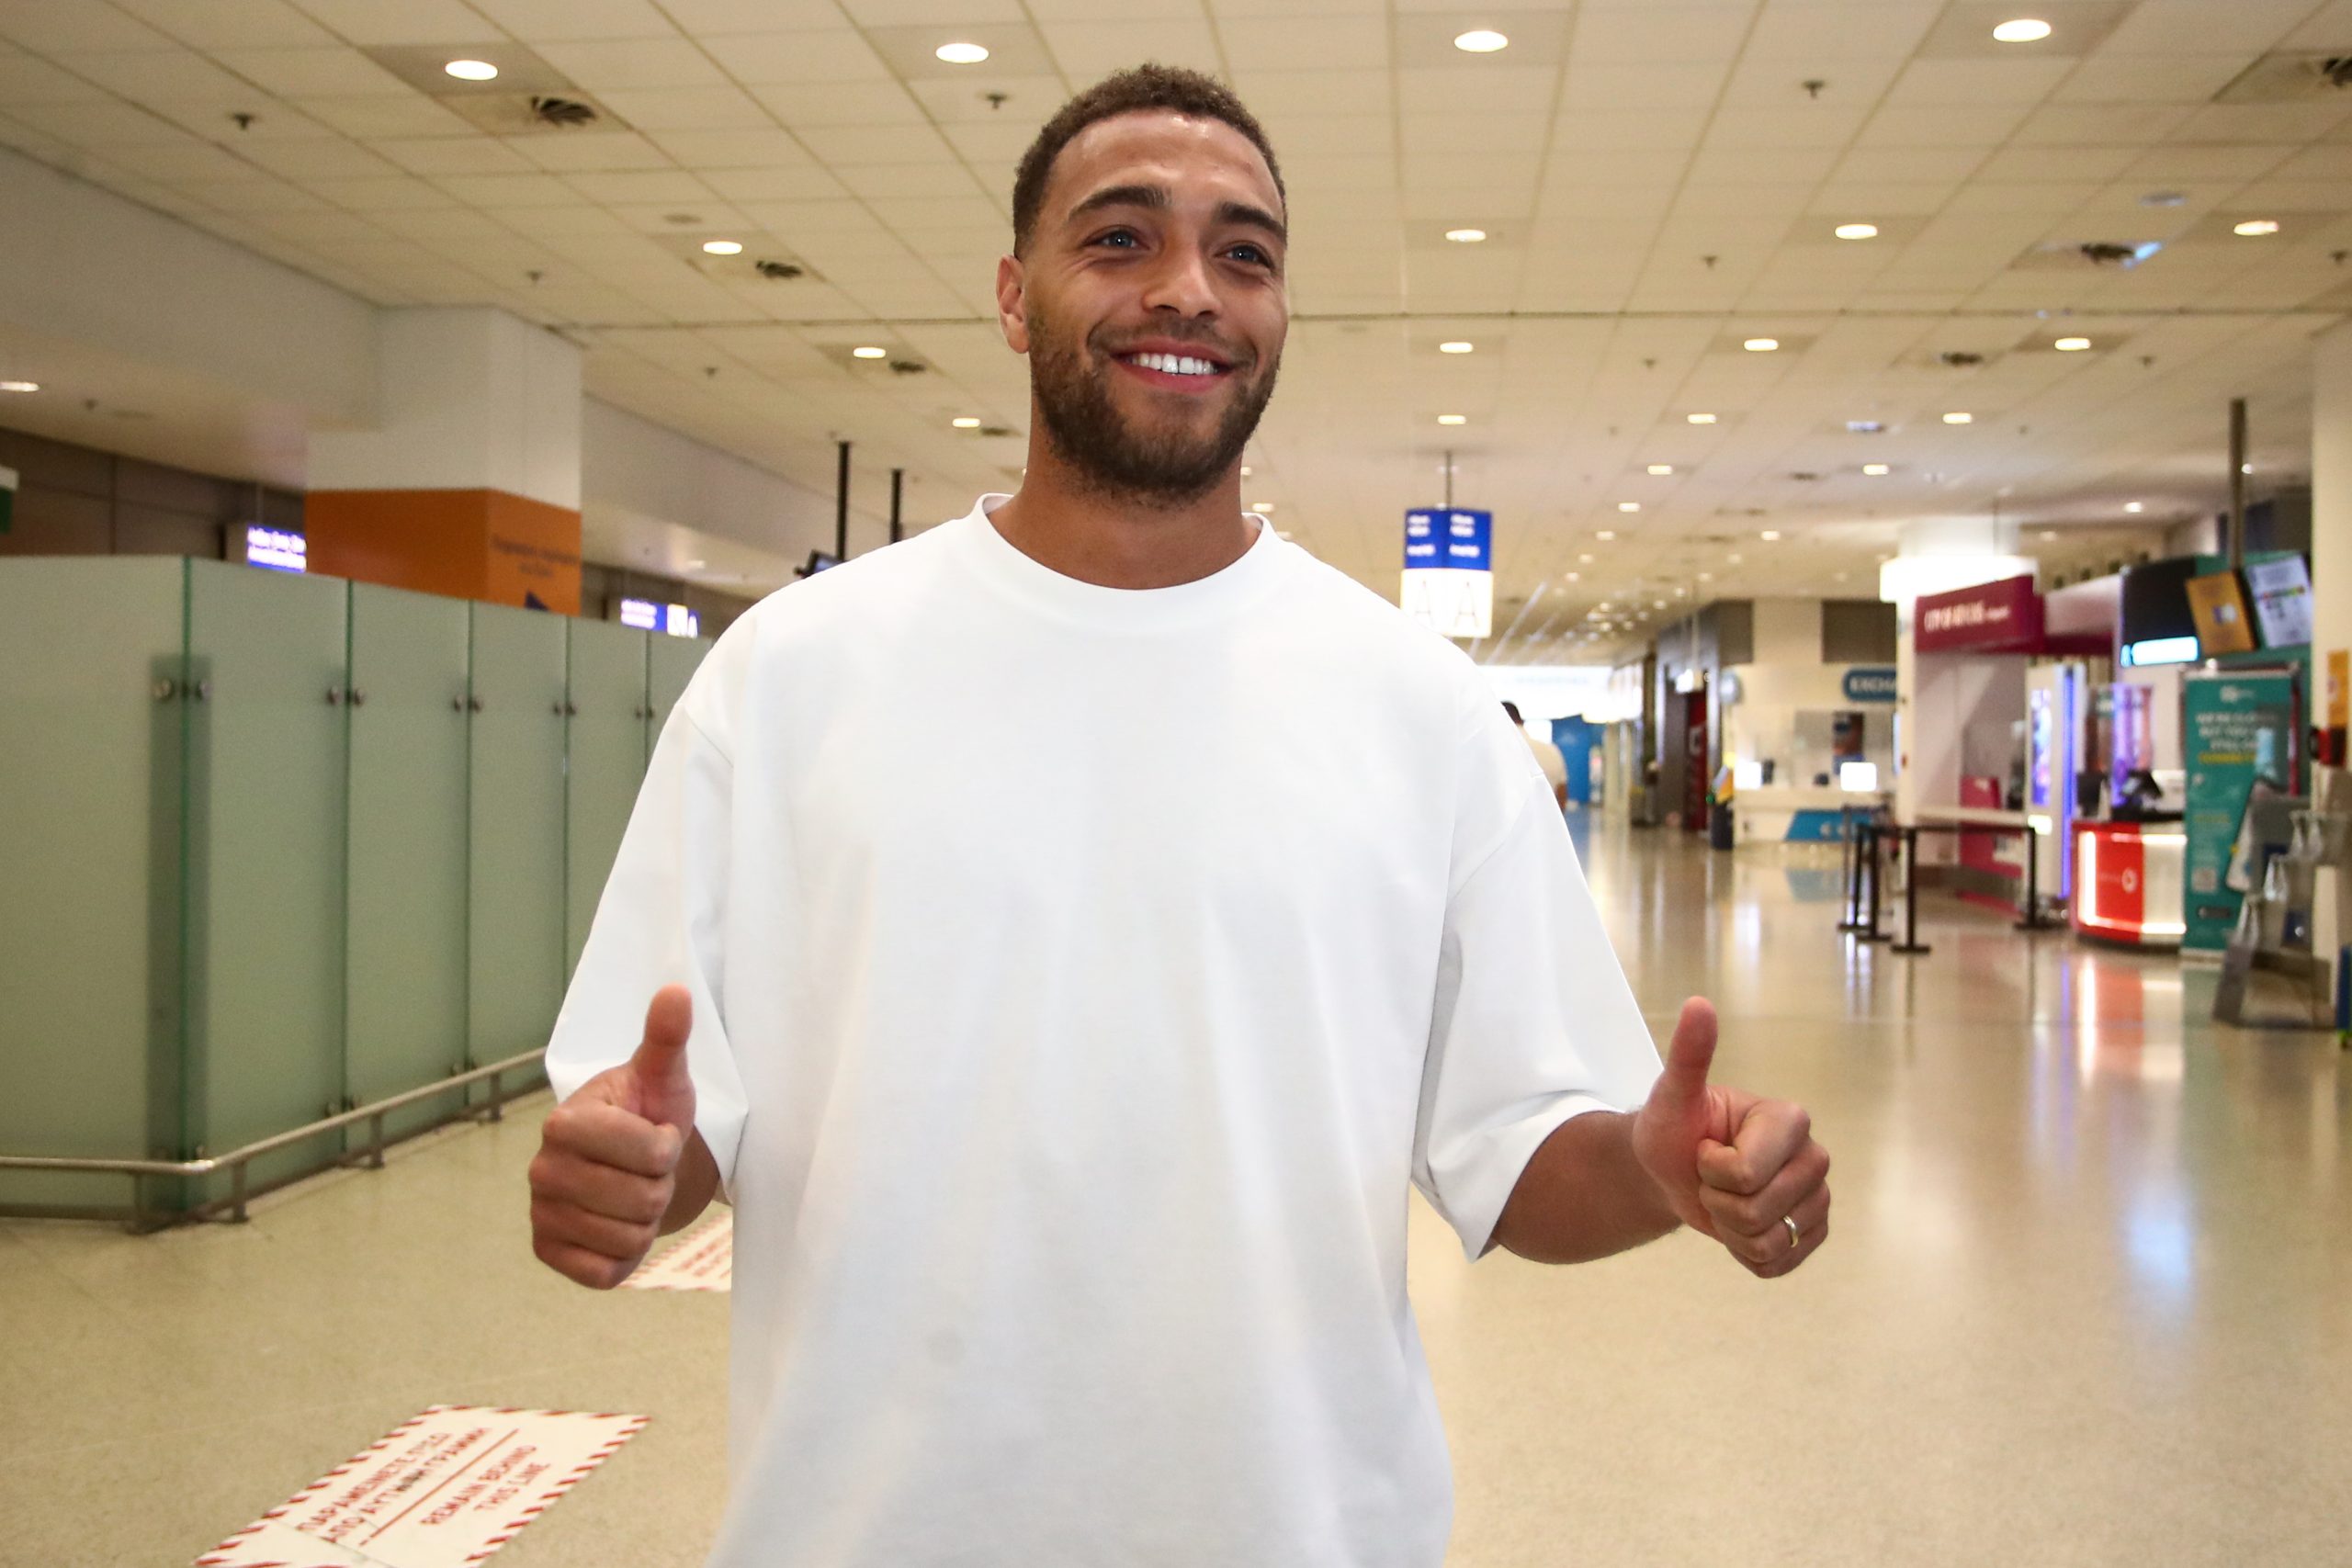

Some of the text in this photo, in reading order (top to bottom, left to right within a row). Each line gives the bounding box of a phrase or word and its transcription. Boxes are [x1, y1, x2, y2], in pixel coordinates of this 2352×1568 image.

[419, 1445, 537, 1525] REMAIN BEHIND
[473, 1461, 550, 1511] THIS LINE
